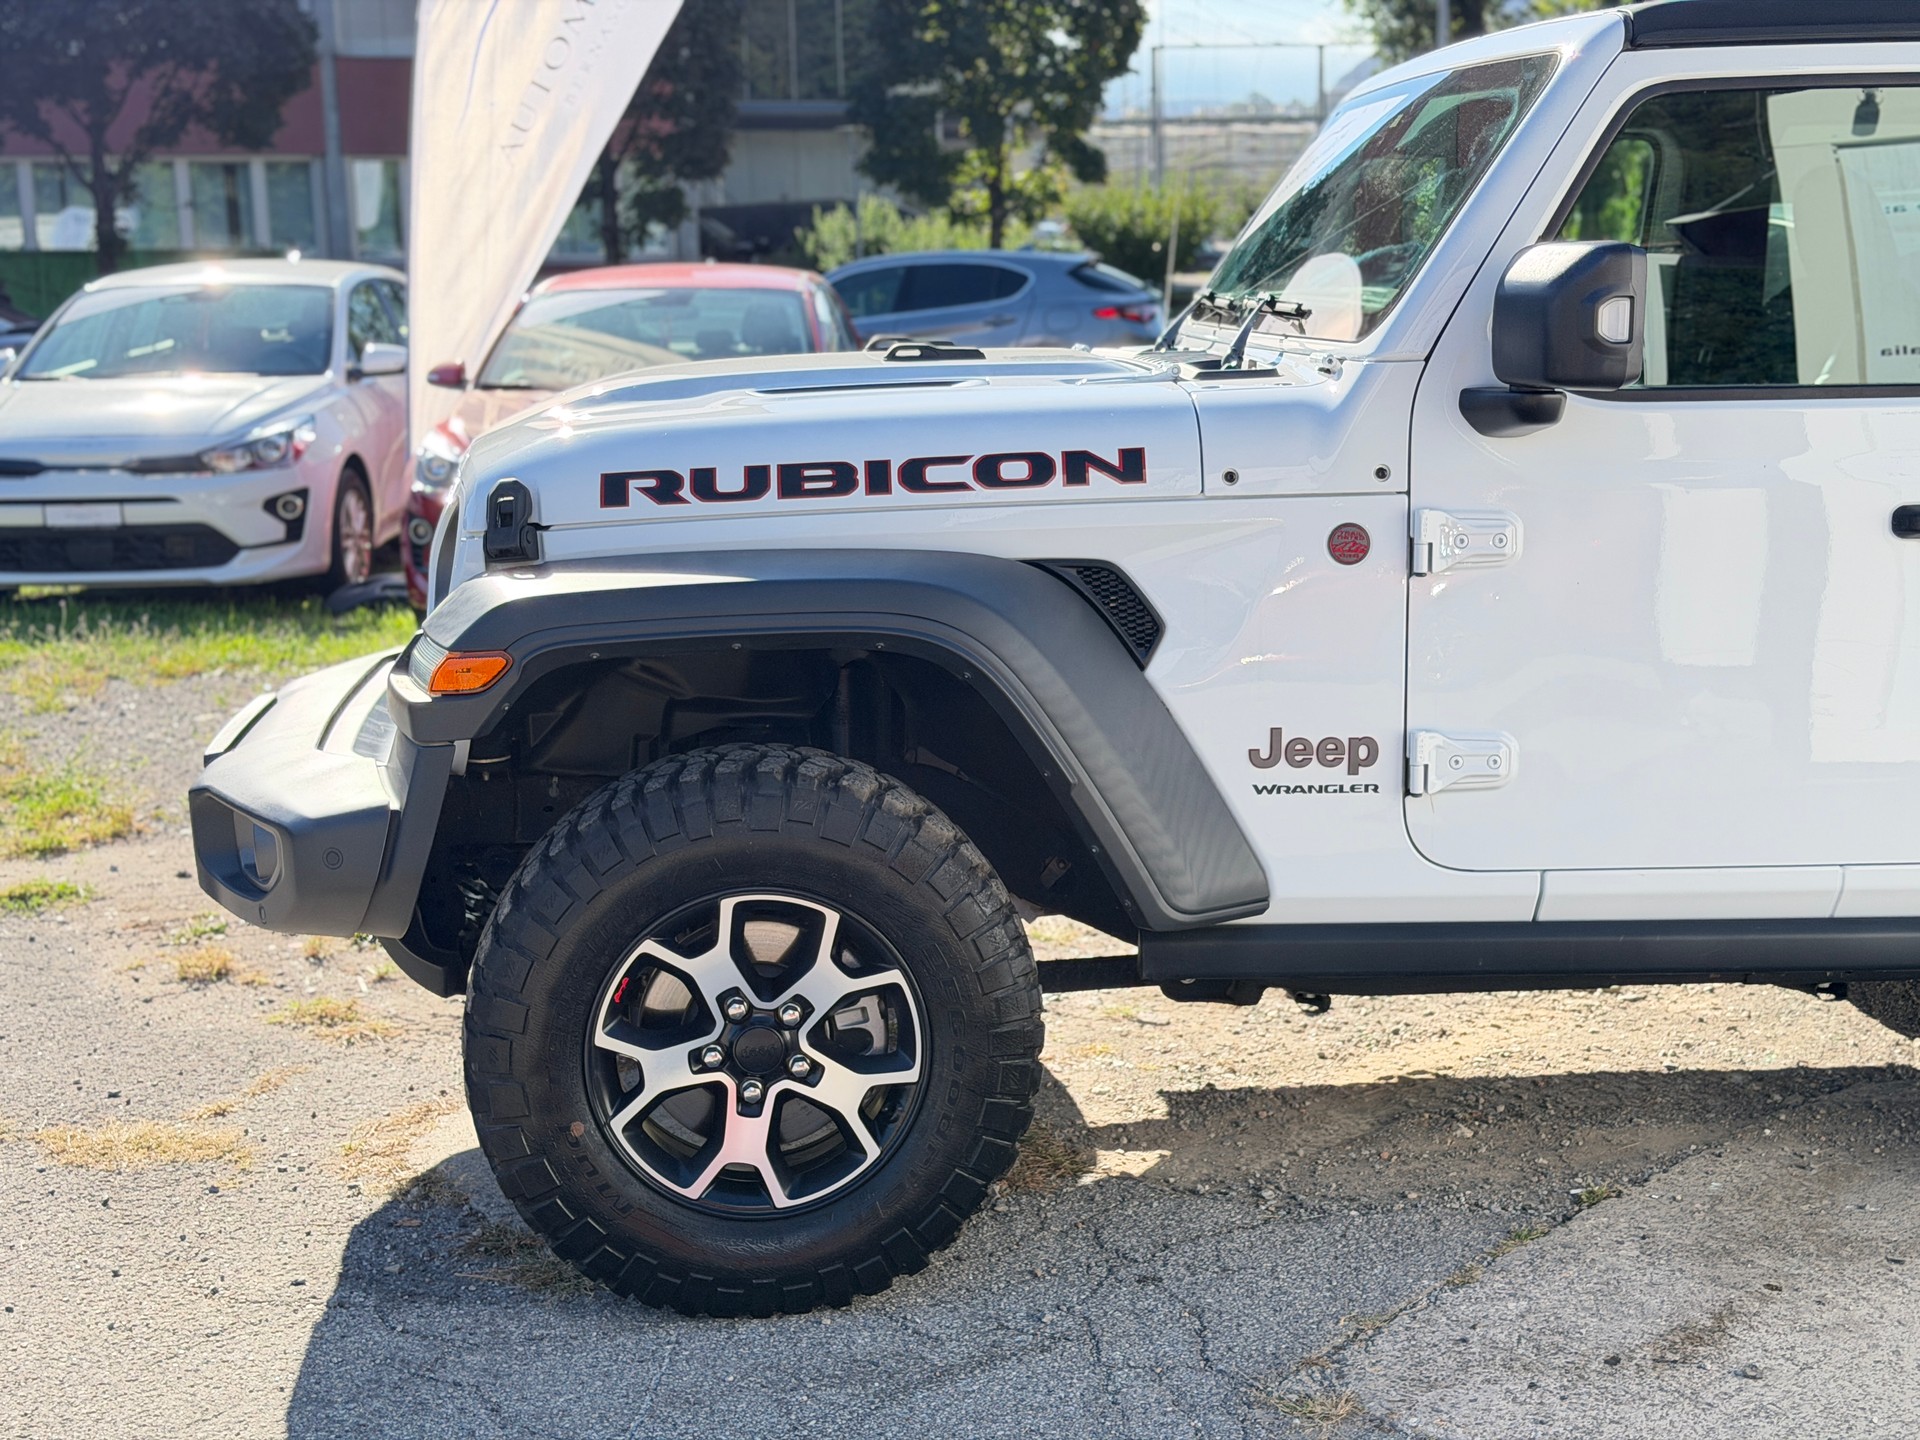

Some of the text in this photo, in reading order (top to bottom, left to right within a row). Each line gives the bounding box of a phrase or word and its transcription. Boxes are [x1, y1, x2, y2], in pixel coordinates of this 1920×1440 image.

[600, 447, 1147, 508] RUBICON
[1248, 727, 1379, 775] Jeep
[1252, 783, 1380, 795] WRANGLER
